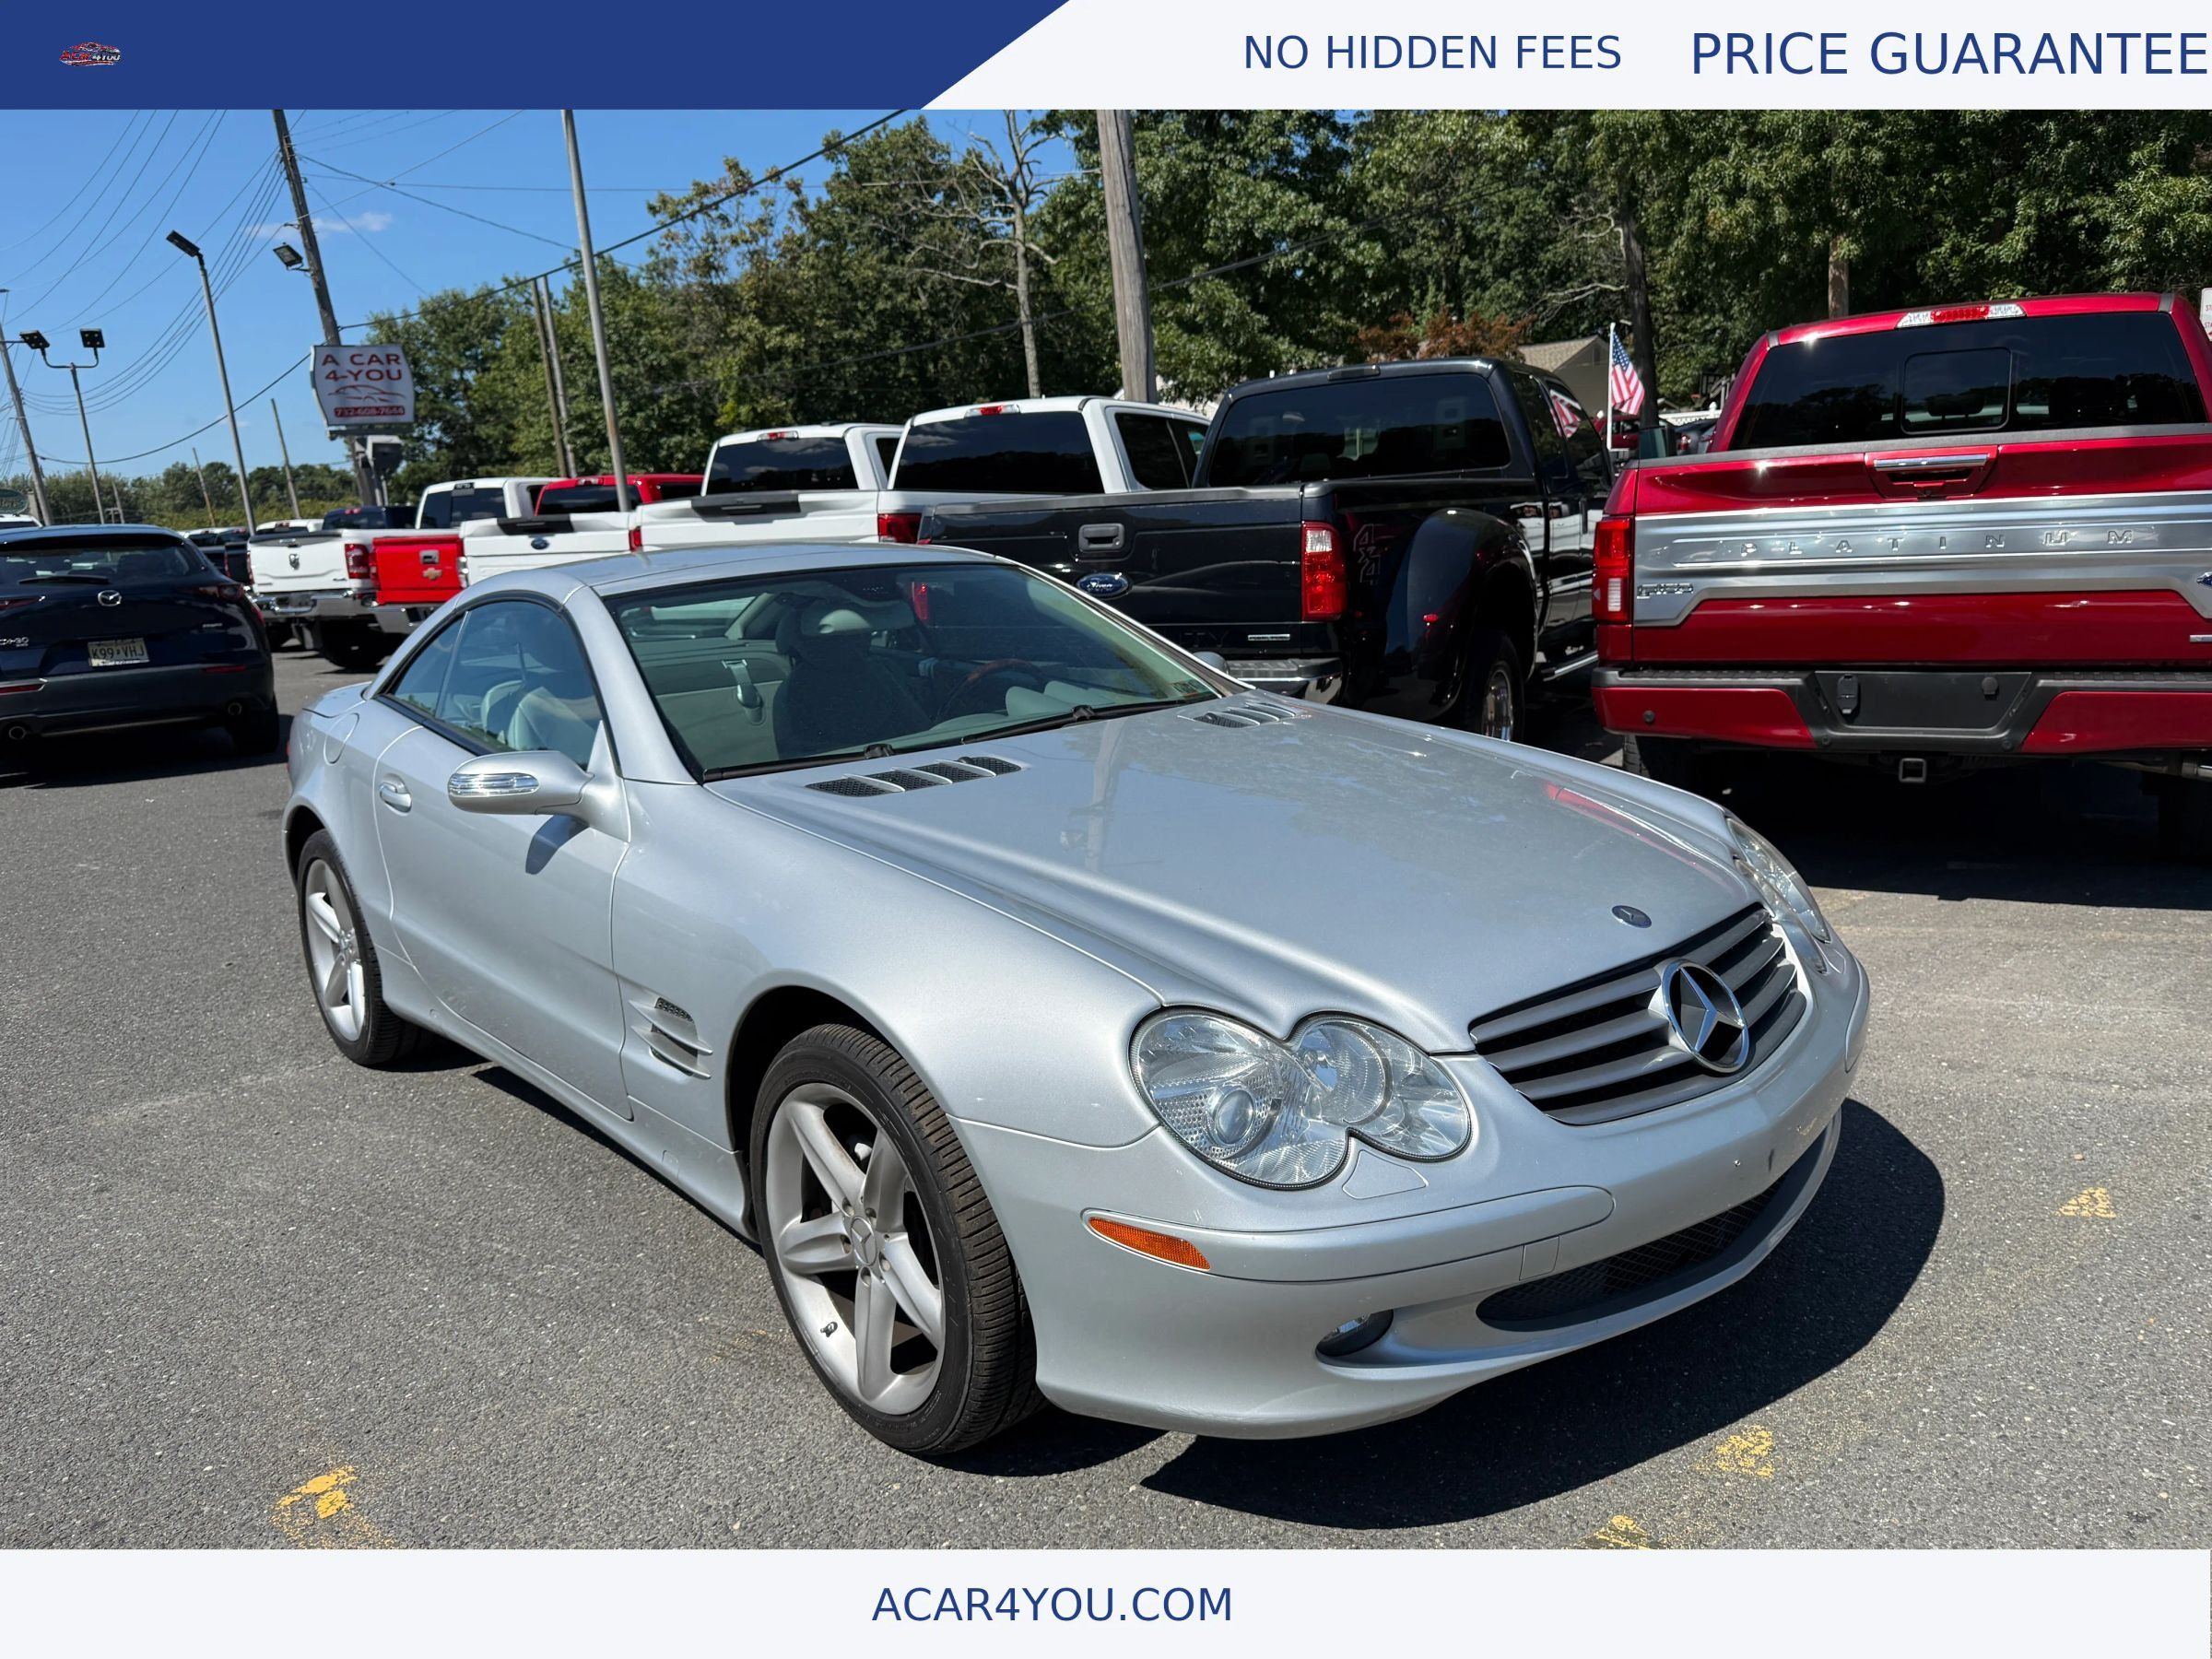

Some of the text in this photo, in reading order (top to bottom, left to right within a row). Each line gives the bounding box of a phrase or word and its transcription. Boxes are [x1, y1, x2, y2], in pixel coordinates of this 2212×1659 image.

[322, 353, 401, 367] A CAR
[324, 369, 403, 382] 4-YOU
[1740, 528, 2134, 557] PLATINUM
